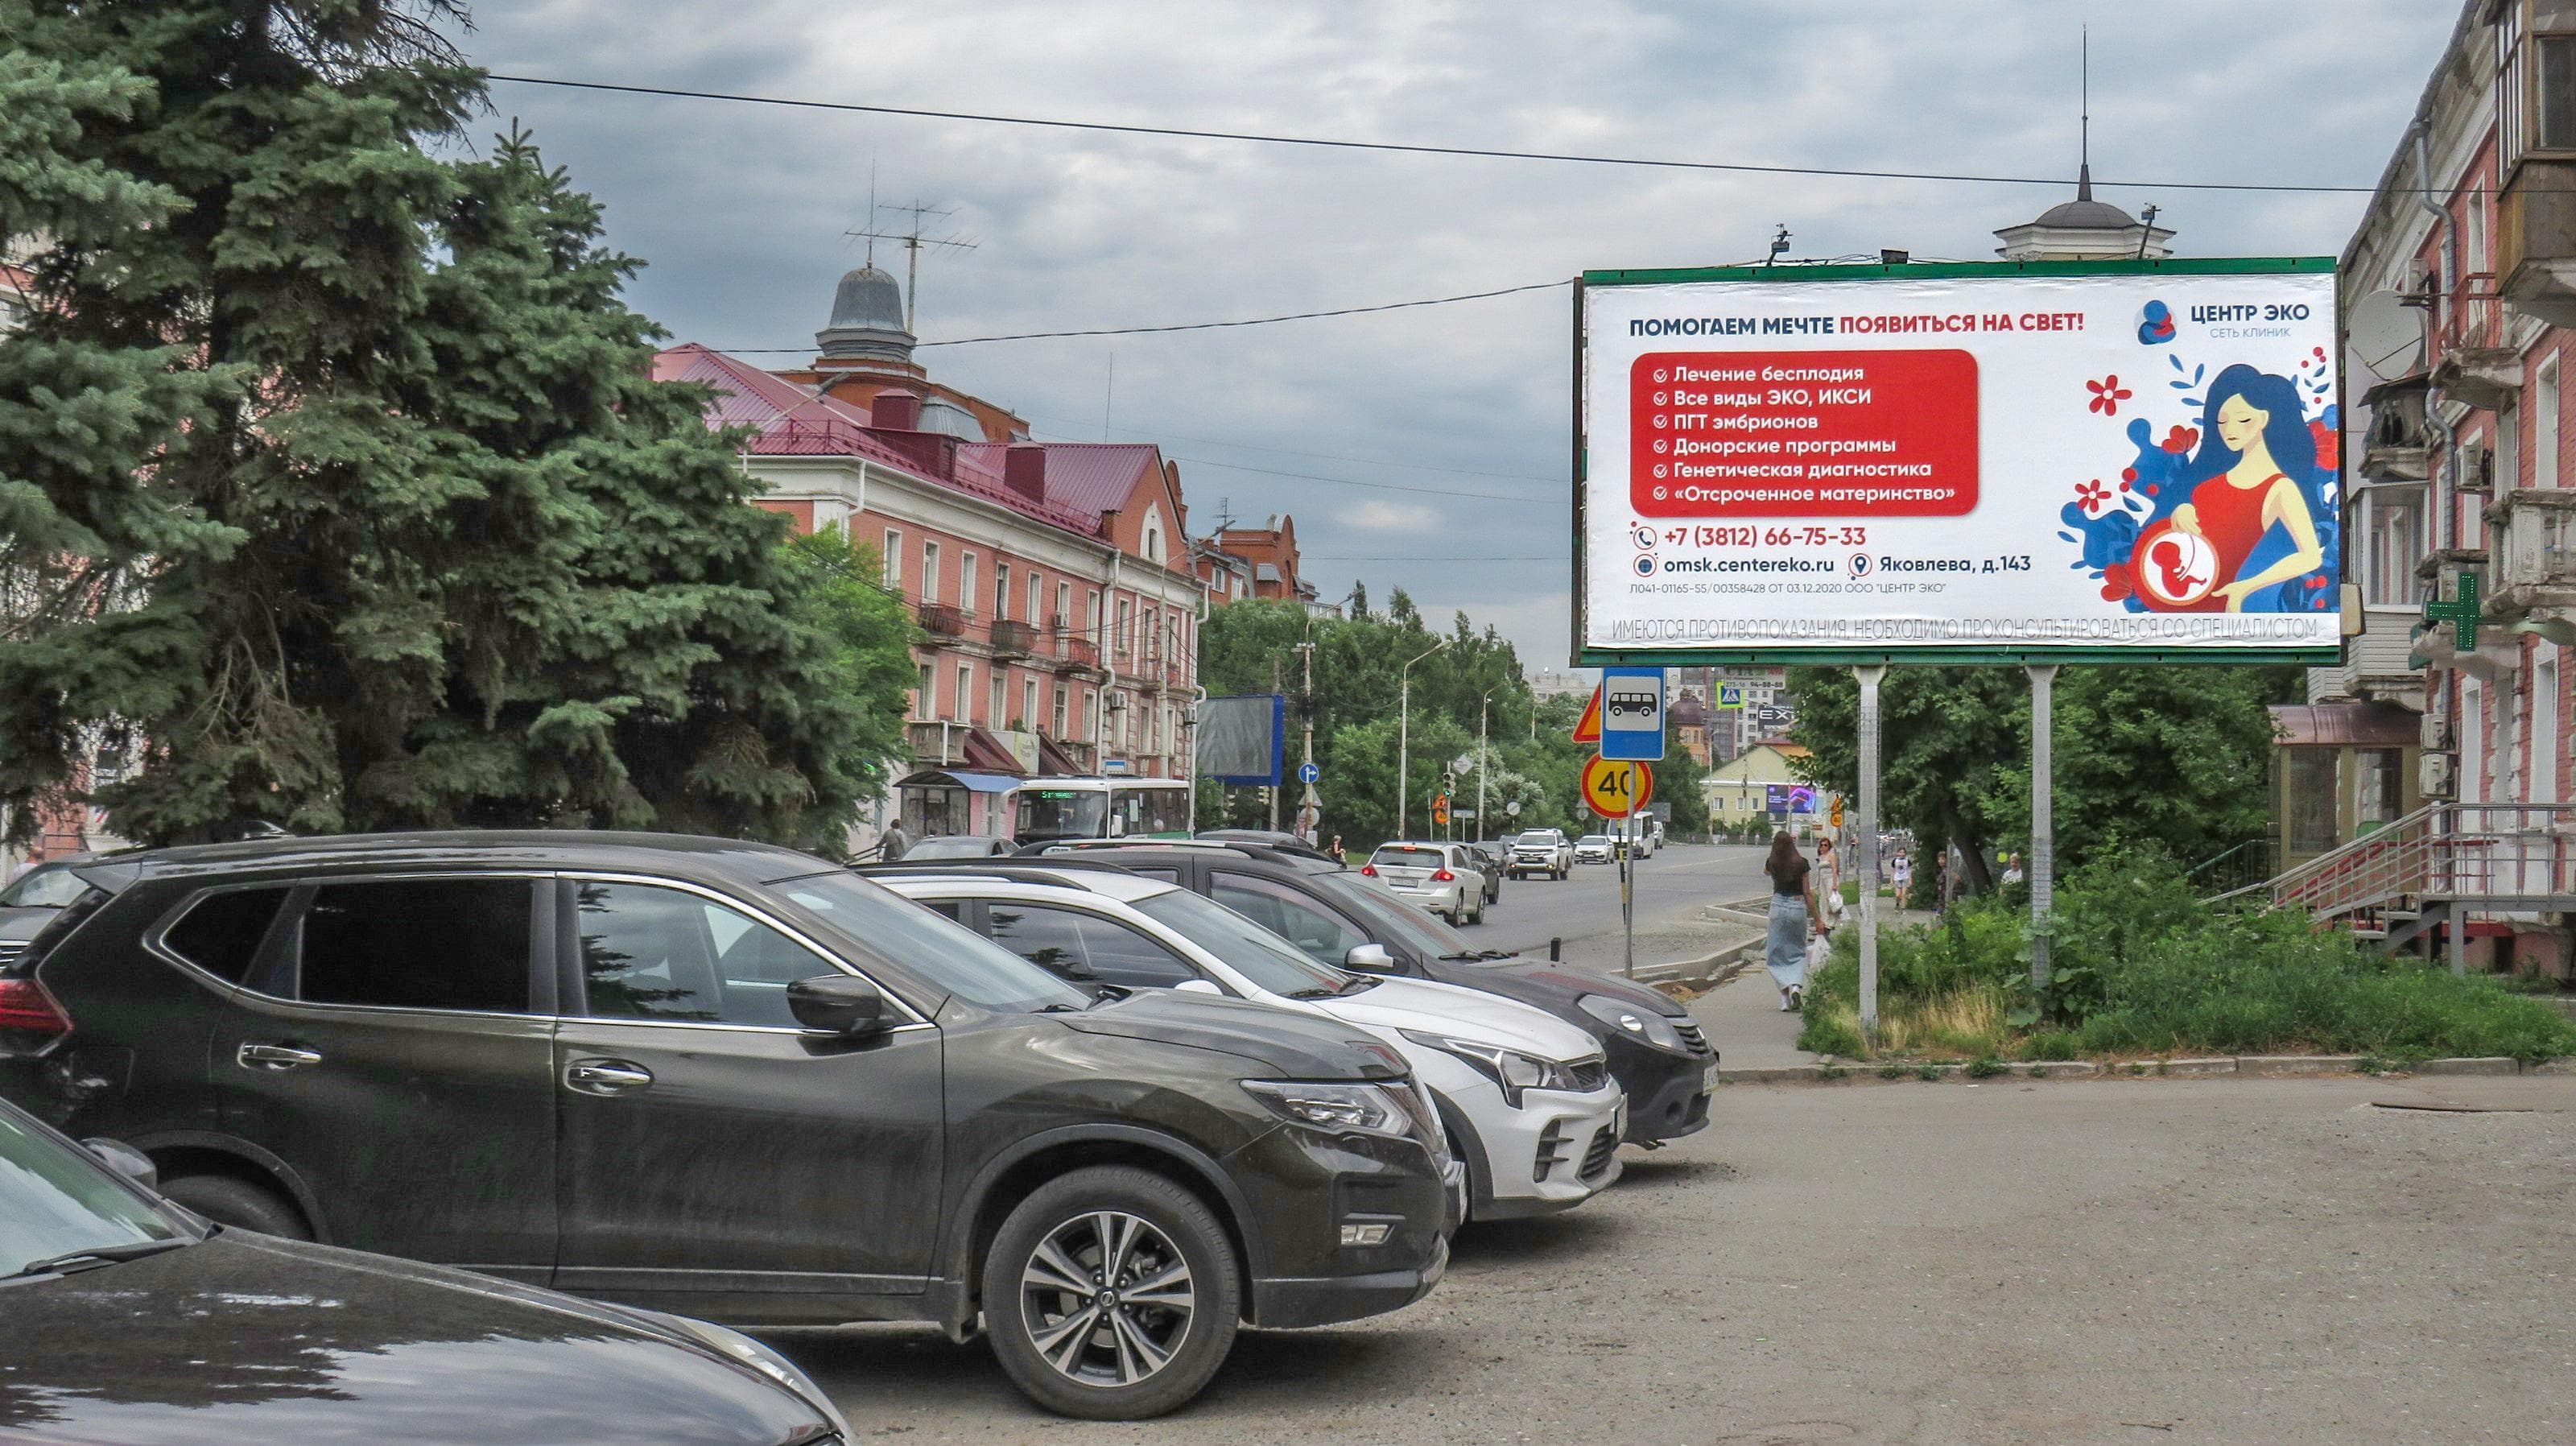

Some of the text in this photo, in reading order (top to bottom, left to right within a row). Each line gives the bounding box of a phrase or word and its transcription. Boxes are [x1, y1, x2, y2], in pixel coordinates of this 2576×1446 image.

[2191, 304, 2309, 324] ЦЕНТР ЭКО
[1631, 313, 2083, 336] ПОМОГАЕМ МЕЧТЕ ПОЯВИТЬСЯ НА СВЕТ!
[2210, 328, 2290, 338] СЕТЬ КЛИНИК
[1674, 366, 1864, 382] Лечение бесплодия
[1675, 389, 1870, 407] Все виды ЭКО, ИКСИ
[1675, 414, 1818, 432] ПГТ эмбрионов
[1674, 438, 1895, 457] Донорские программы
[1674, 462, 1931, 479] Генетическая диагностика
[1675, 486, 1955, 503] «Отсроченное материнство»
[1666, 526, 1865, 547] +7 (3812) 66-75-33
[1665, 557, 1833, 572] omsk.centereko.ru
[1880, 556, 2030, 573] Яковлева, д.143
[1630, 584, 1765, 593] Л041-01165-55/00358428
[1769, 584, 1783, 593] ОТ
[1787, 584, 1842, 593] 03.12.2020
[1845, 584, 1873, 593] ООО
[1876, 584, 1915, 593] "ЦЕНТР
[1612, 618, 2317, 641] ИМЕЮТСЯ ПРОТИВОПОКАЗАНИЯ, НЕОБХОДИМО ПРОКОНСУЛЬТИРОВАТЬСЯ СО СПЕЦИАЛИСТОМ
[1598, 770, 1629, 796] 40
